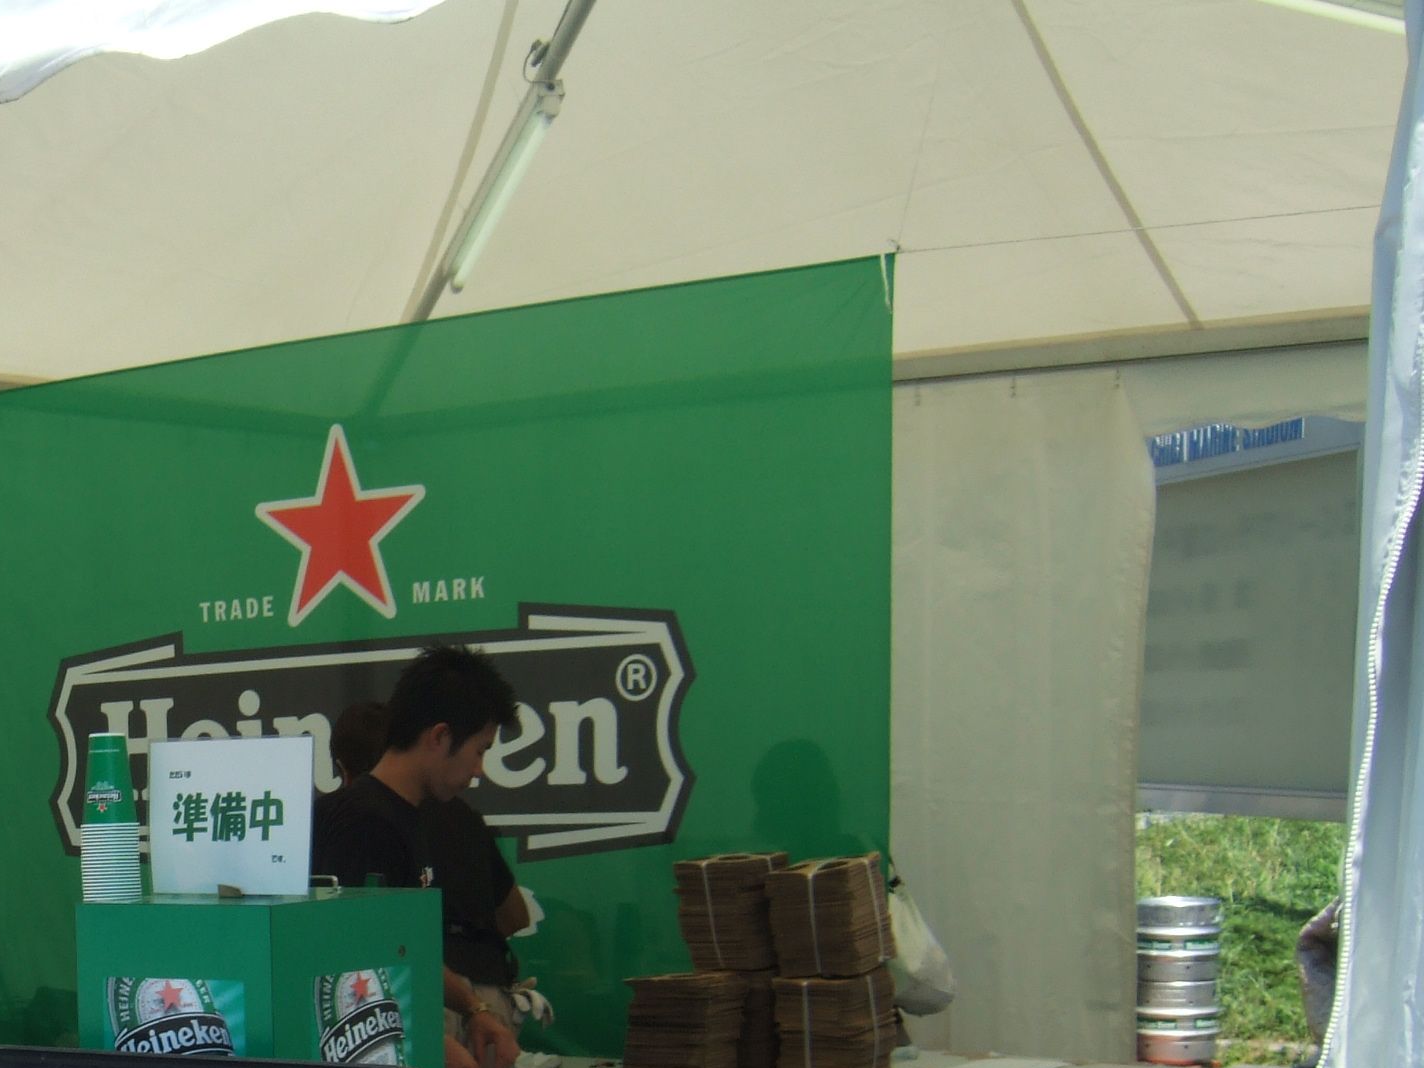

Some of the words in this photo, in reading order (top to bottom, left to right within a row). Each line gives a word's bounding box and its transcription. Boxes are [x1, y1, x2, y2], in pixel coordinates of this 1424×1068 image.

[199, 596, 275, 623] TRADE
[411, 576, 486, 604] MARK
[172, 790, 285, 842] 準備中
